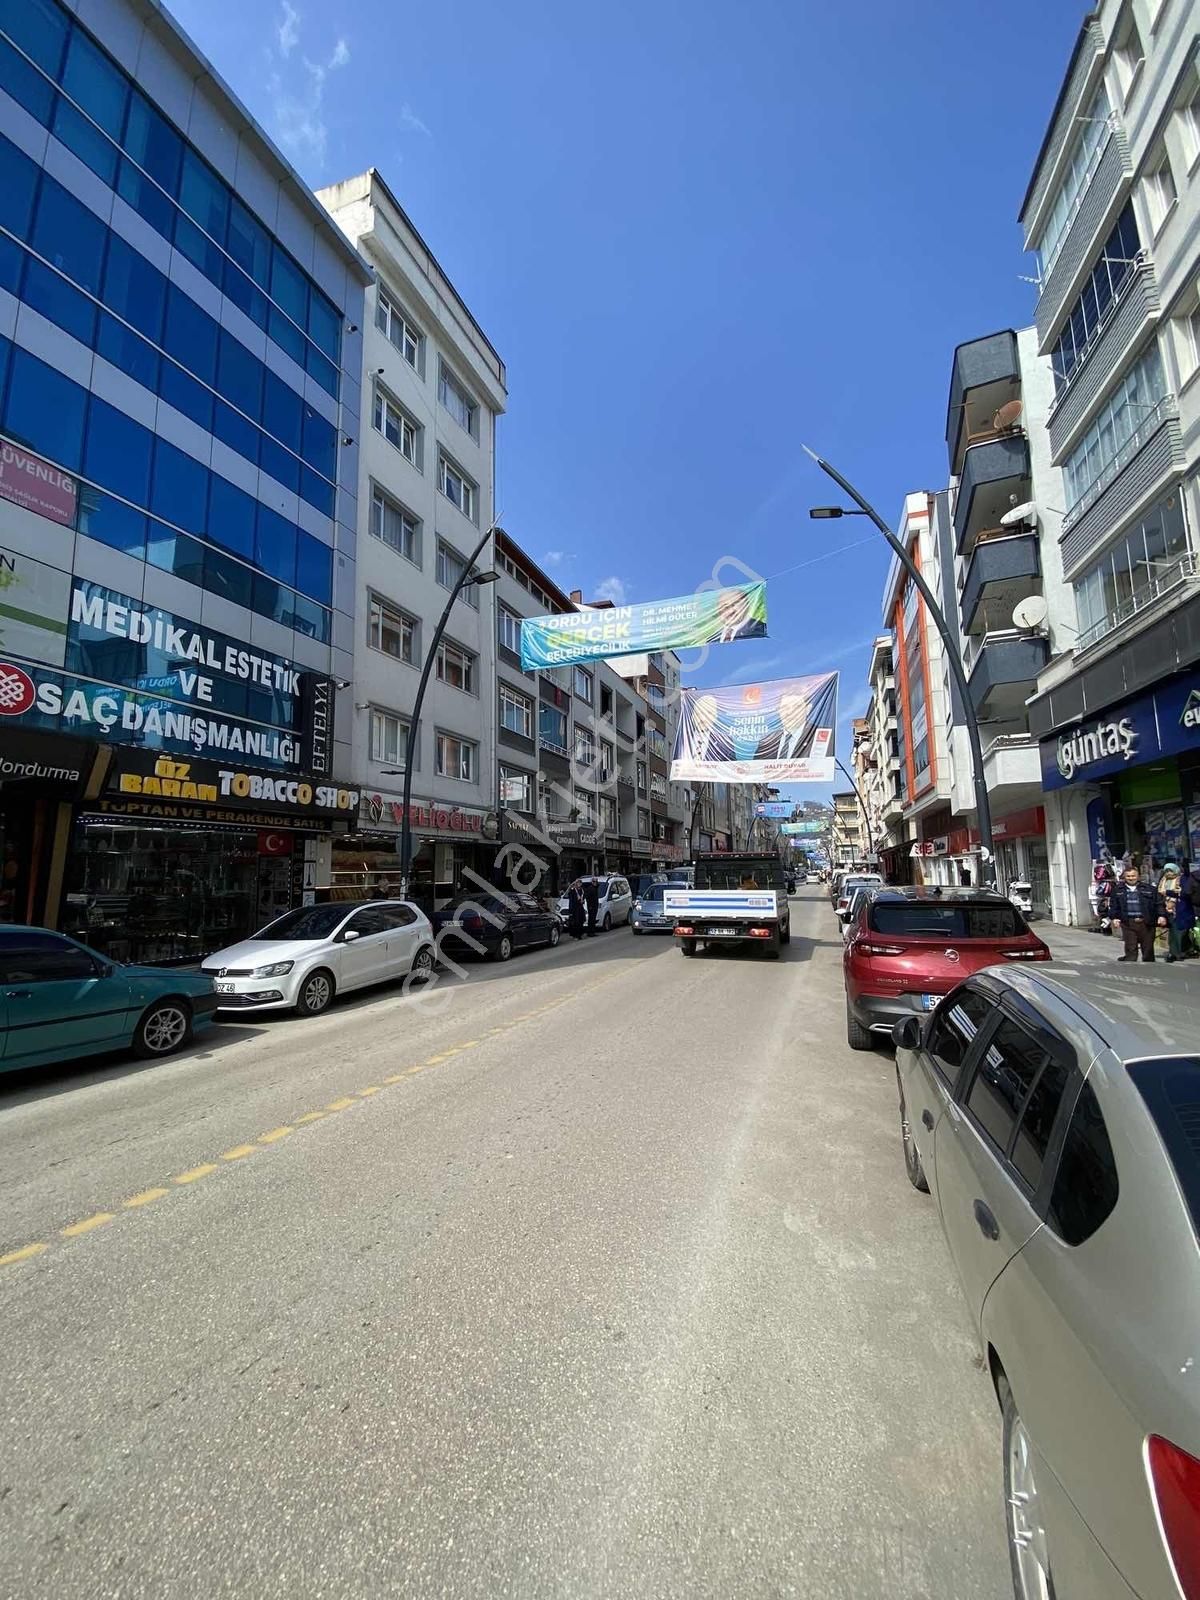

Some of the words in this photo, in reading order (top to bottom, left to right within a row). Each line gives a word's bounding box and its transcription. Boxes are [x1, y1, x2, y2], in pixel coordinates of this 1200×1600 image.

[549, 613, 592, 630] ORDU
[658, 602, 698, 616] MEHMET
[71, 588, 222, 670] MEDİKAL
[225, 646, 300, 697] ESTETİK
[179, 670, 213, 702] VE
[36, 683, 119, 733] SAÇ
[121, 701, 300, 764] DANIŞMANLIĞI
[312, 681, 328, 773] EFTELYA
[1059, 717, 1138, 780] güntaş
[154, 754, 192, 781] ÖZ
[218, 770, 312, 805] TOBACCO
[315, 786, 359, 811] SHOP
[206, 810, 293, 827] PERAKENDE
[390, 800, 481, 833] VELİOĞLU
